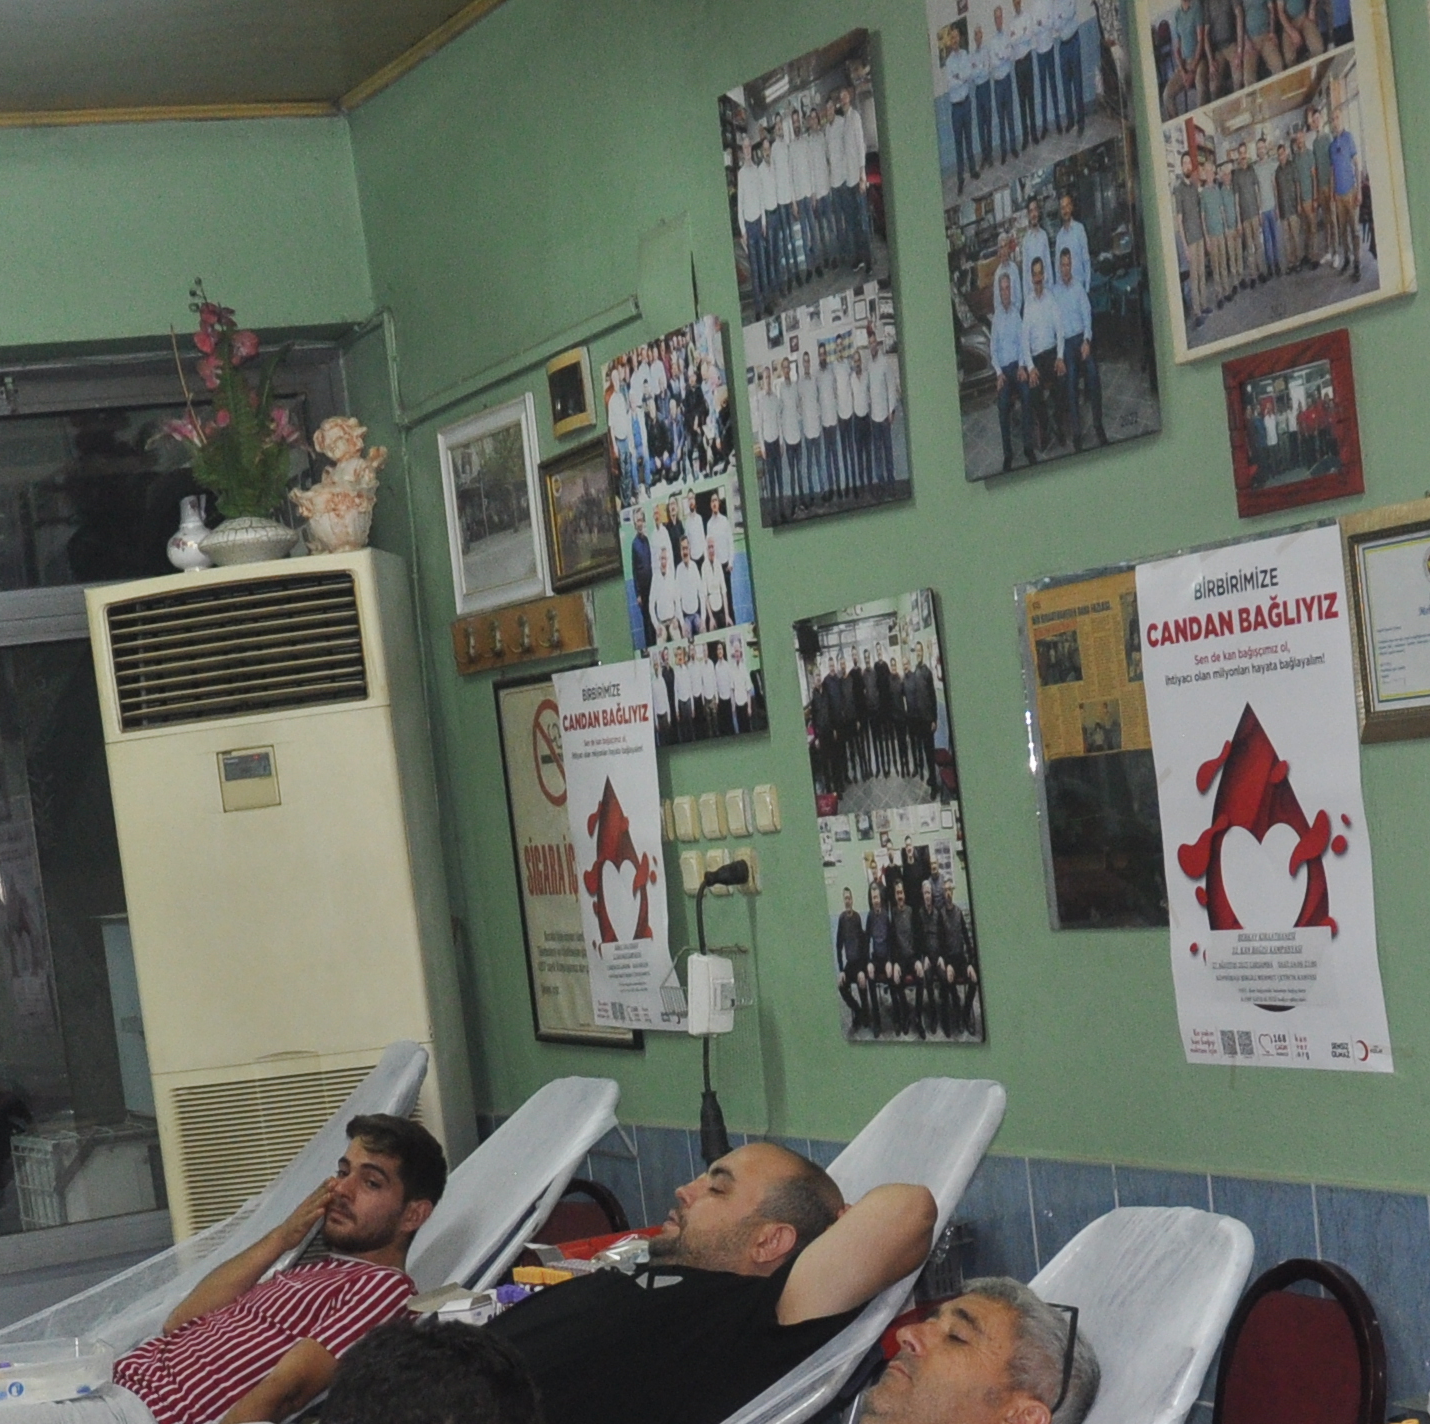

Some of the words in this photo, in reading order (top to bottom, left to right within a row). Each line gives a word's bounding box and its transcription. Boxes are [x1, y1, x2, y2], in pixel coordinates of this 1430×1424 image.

[1194, 566, 1279, 600] BİRBİRİMİZE
[1146, 610, 1235, 648] CANDAN
[1238, 591, 1339, 634] BAĞLIYIZ
[1194, 655, 1209, 665] Sen
[1211, 652, 1221, 662] de
[1223, 650, 1236, 661] kan
[1194, 671, 1211, 682] olan
[1252, 661, 1278, 676] hayata
[563, 709, 601, 732] CANDAN
[602, 702, 649, 728] BAĞLIYIZ
[524, 836, 567, 896] SİGARA
